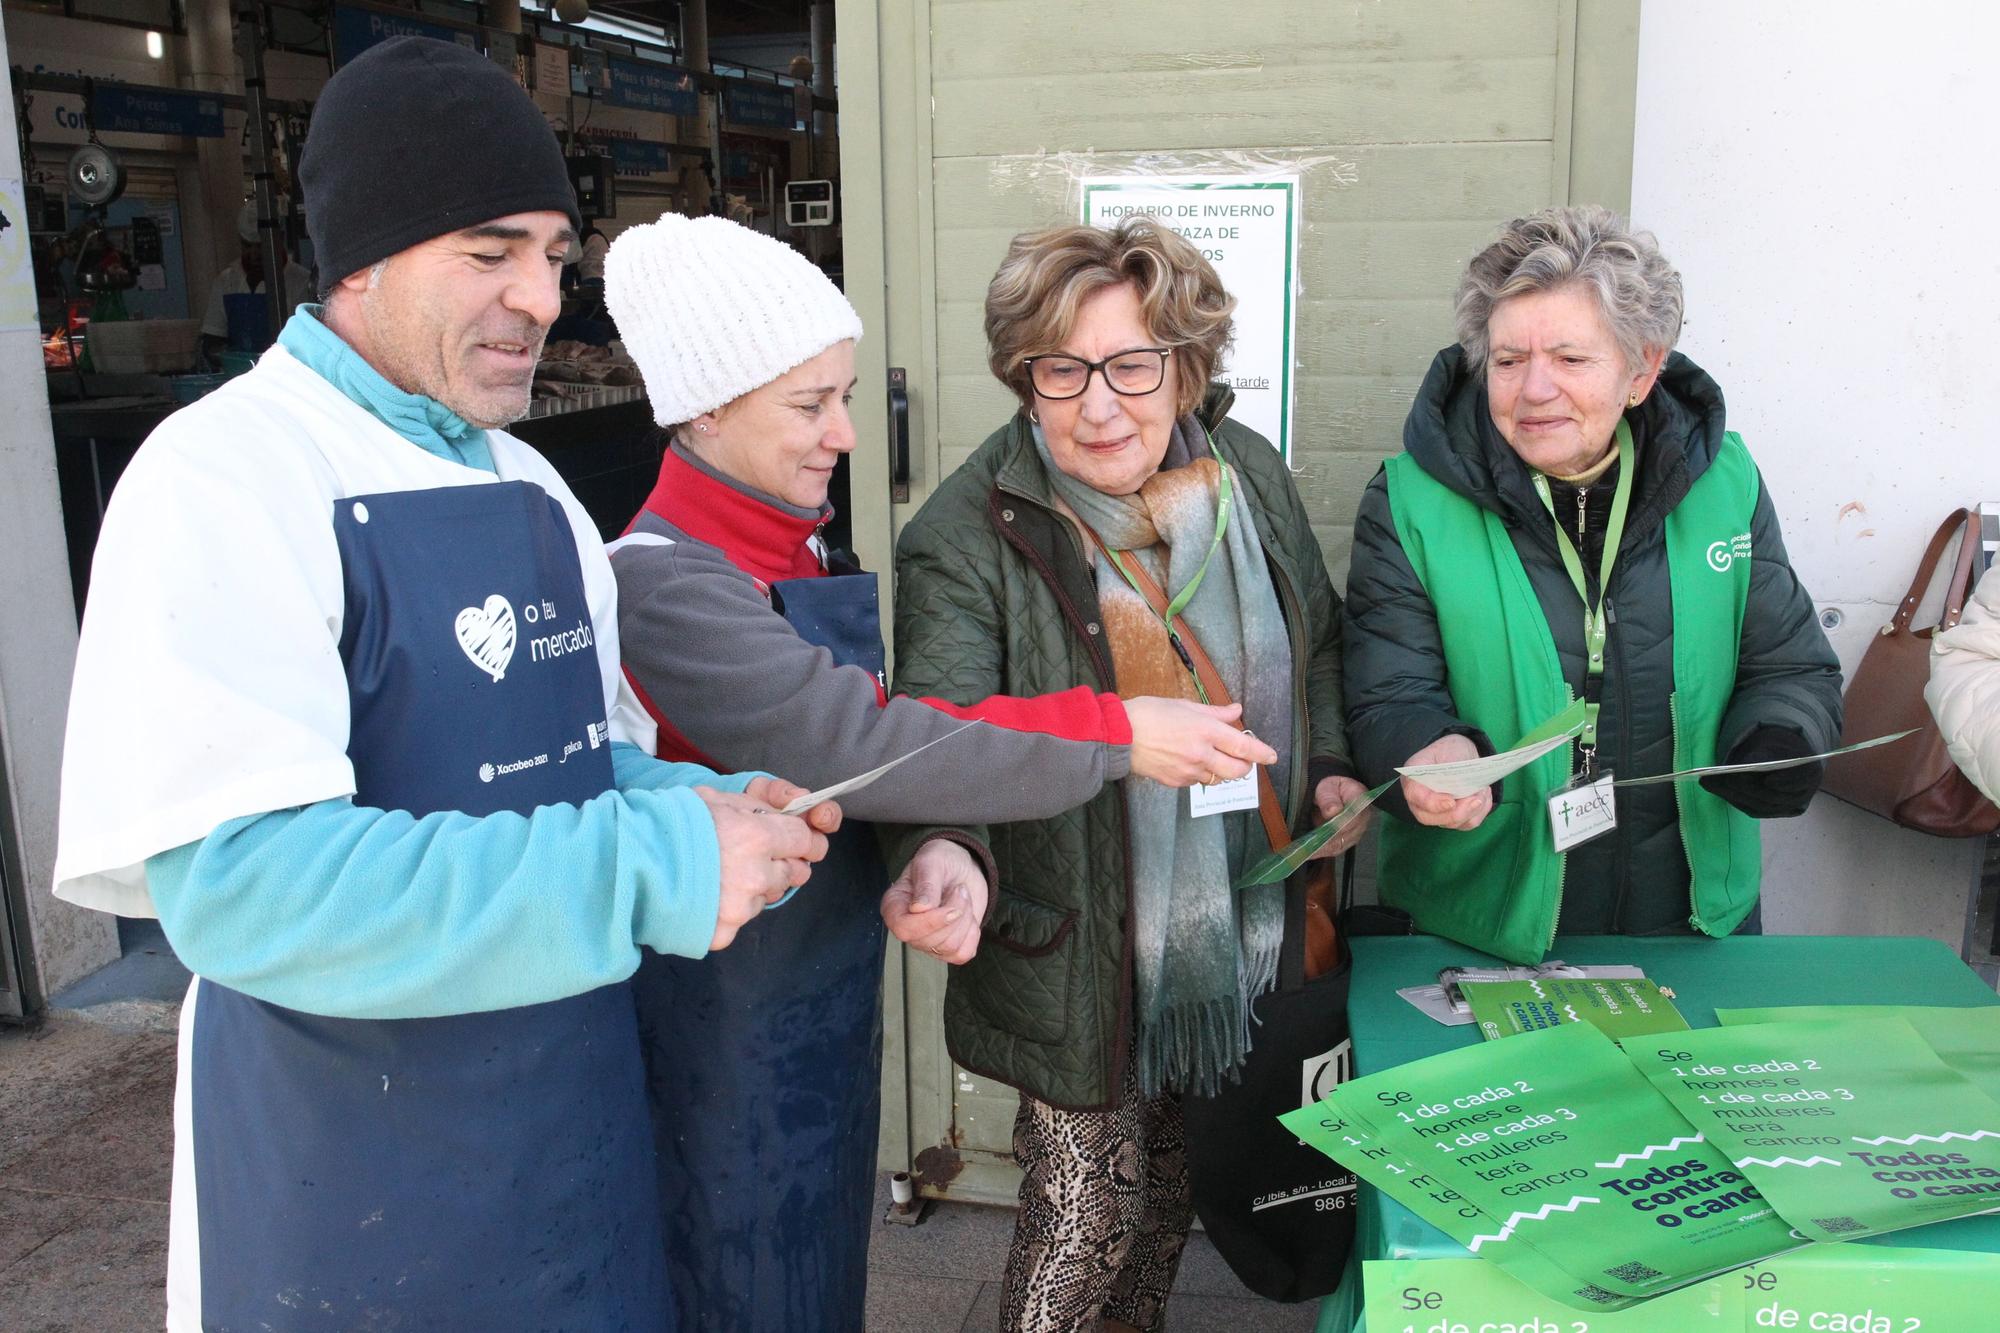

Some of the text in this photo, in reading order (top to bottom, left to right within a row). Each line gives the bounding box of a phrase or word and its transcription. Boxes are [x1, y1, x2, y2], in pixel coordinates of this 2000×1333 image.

[1101, 205, 1275, 217] HORARIO DE INVERNO
[1218, 227, 1240, 239] DE
[1236, 376, 1270, 388] tarde
[541, 599, 556, 621] teu
[531, 619, 593, 662] mercado
[497, 753, 549, 776] Xacobeo 2021
[1602, 994, 1618, 1010] cada
[1631, 993, 1648, 1010] cada
[1526, 1001, 1548, 1029] contra
[1541, 1001, 1561, 1026] Todos
[1657, 1050, 1693, 1062] Se
[1671, 1059, 1822, 1076] 1 de cada 2
[1682, 1076, 1800, 1090] homes e
[1377, 1091, 1413, 1106] Se
[1397, 1081, 1534, 1123] 1 de cada 2
[1698, 1088, 1855, 1104] 1 de cada 3
[1712, 1105, 1835, 1119] mulleres
[1412, 1104, 1522, 1138] homes e
[1726, 1120, 1786, 1133] terá
[1435, 1108, 1577, 1153] 1 de cada 3
[1456, 1129, 1568, 1167] mulleres
[1743, 1135, 1841, 1147] cancro
[1847, 1151, 1970, 1167] Todos
[1475, 1160, 1533, 1182] terá
[1599, 1159, 1708, 1196] Todos
[1871, 1166, 2000, 1182] contra
[1292, 1185, 1308, 1196] s/n
[1318, 1175, 1347, 1189] Local
[1501, 1168, 1589, 1196] cancro
[1631, 1170, 1745, 1211] contra
[1890, 1187, 1918, 1199] o
[1315, 1195, 1346, 1211] 986
[1656, 1213, 1682, 1227] o
[1402, 1287, 1443, 1310] Se
[1755, 1301, 1800, 1328] de
[1808, 1309, 1891, 1333] cada
